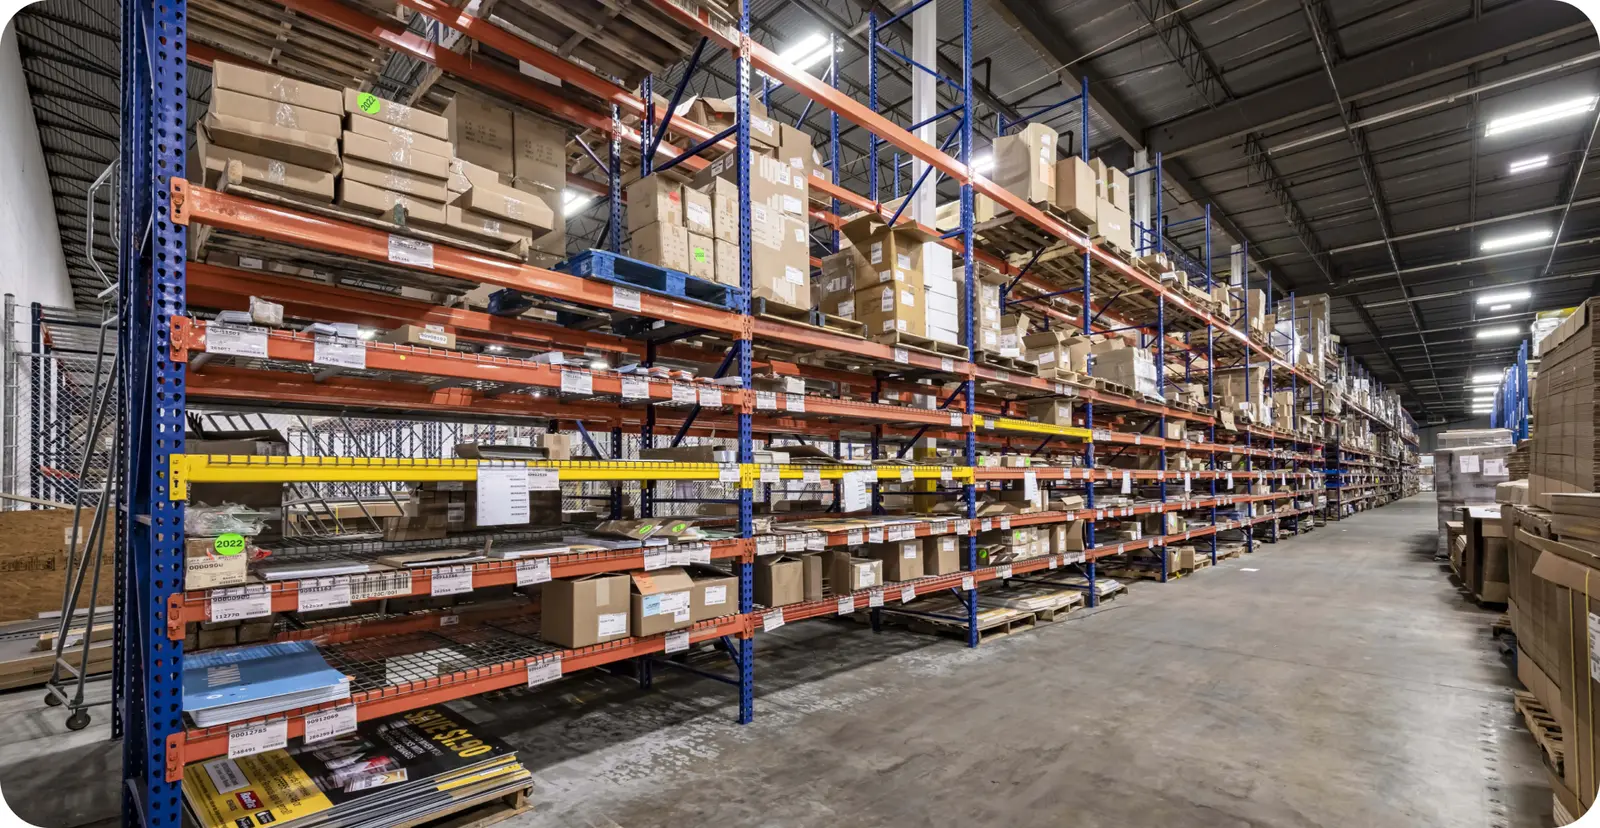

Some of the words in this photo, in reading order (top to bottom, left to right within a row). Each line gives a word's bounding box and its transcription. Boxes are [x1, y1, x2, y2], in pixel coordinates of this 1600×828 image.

[361, 95, 376, 111] 2022
[216, 539, 243, 548] 2022
[207, 663, 241, 688] WINE
[306, 713, 339, 725] 90912069
[230, 727, 267, 739] 90012785
[404, 709, 458, 733] SAVE
[432, 728, 492, 758] $1.90
[419, 738, 435, 751] WHEN
